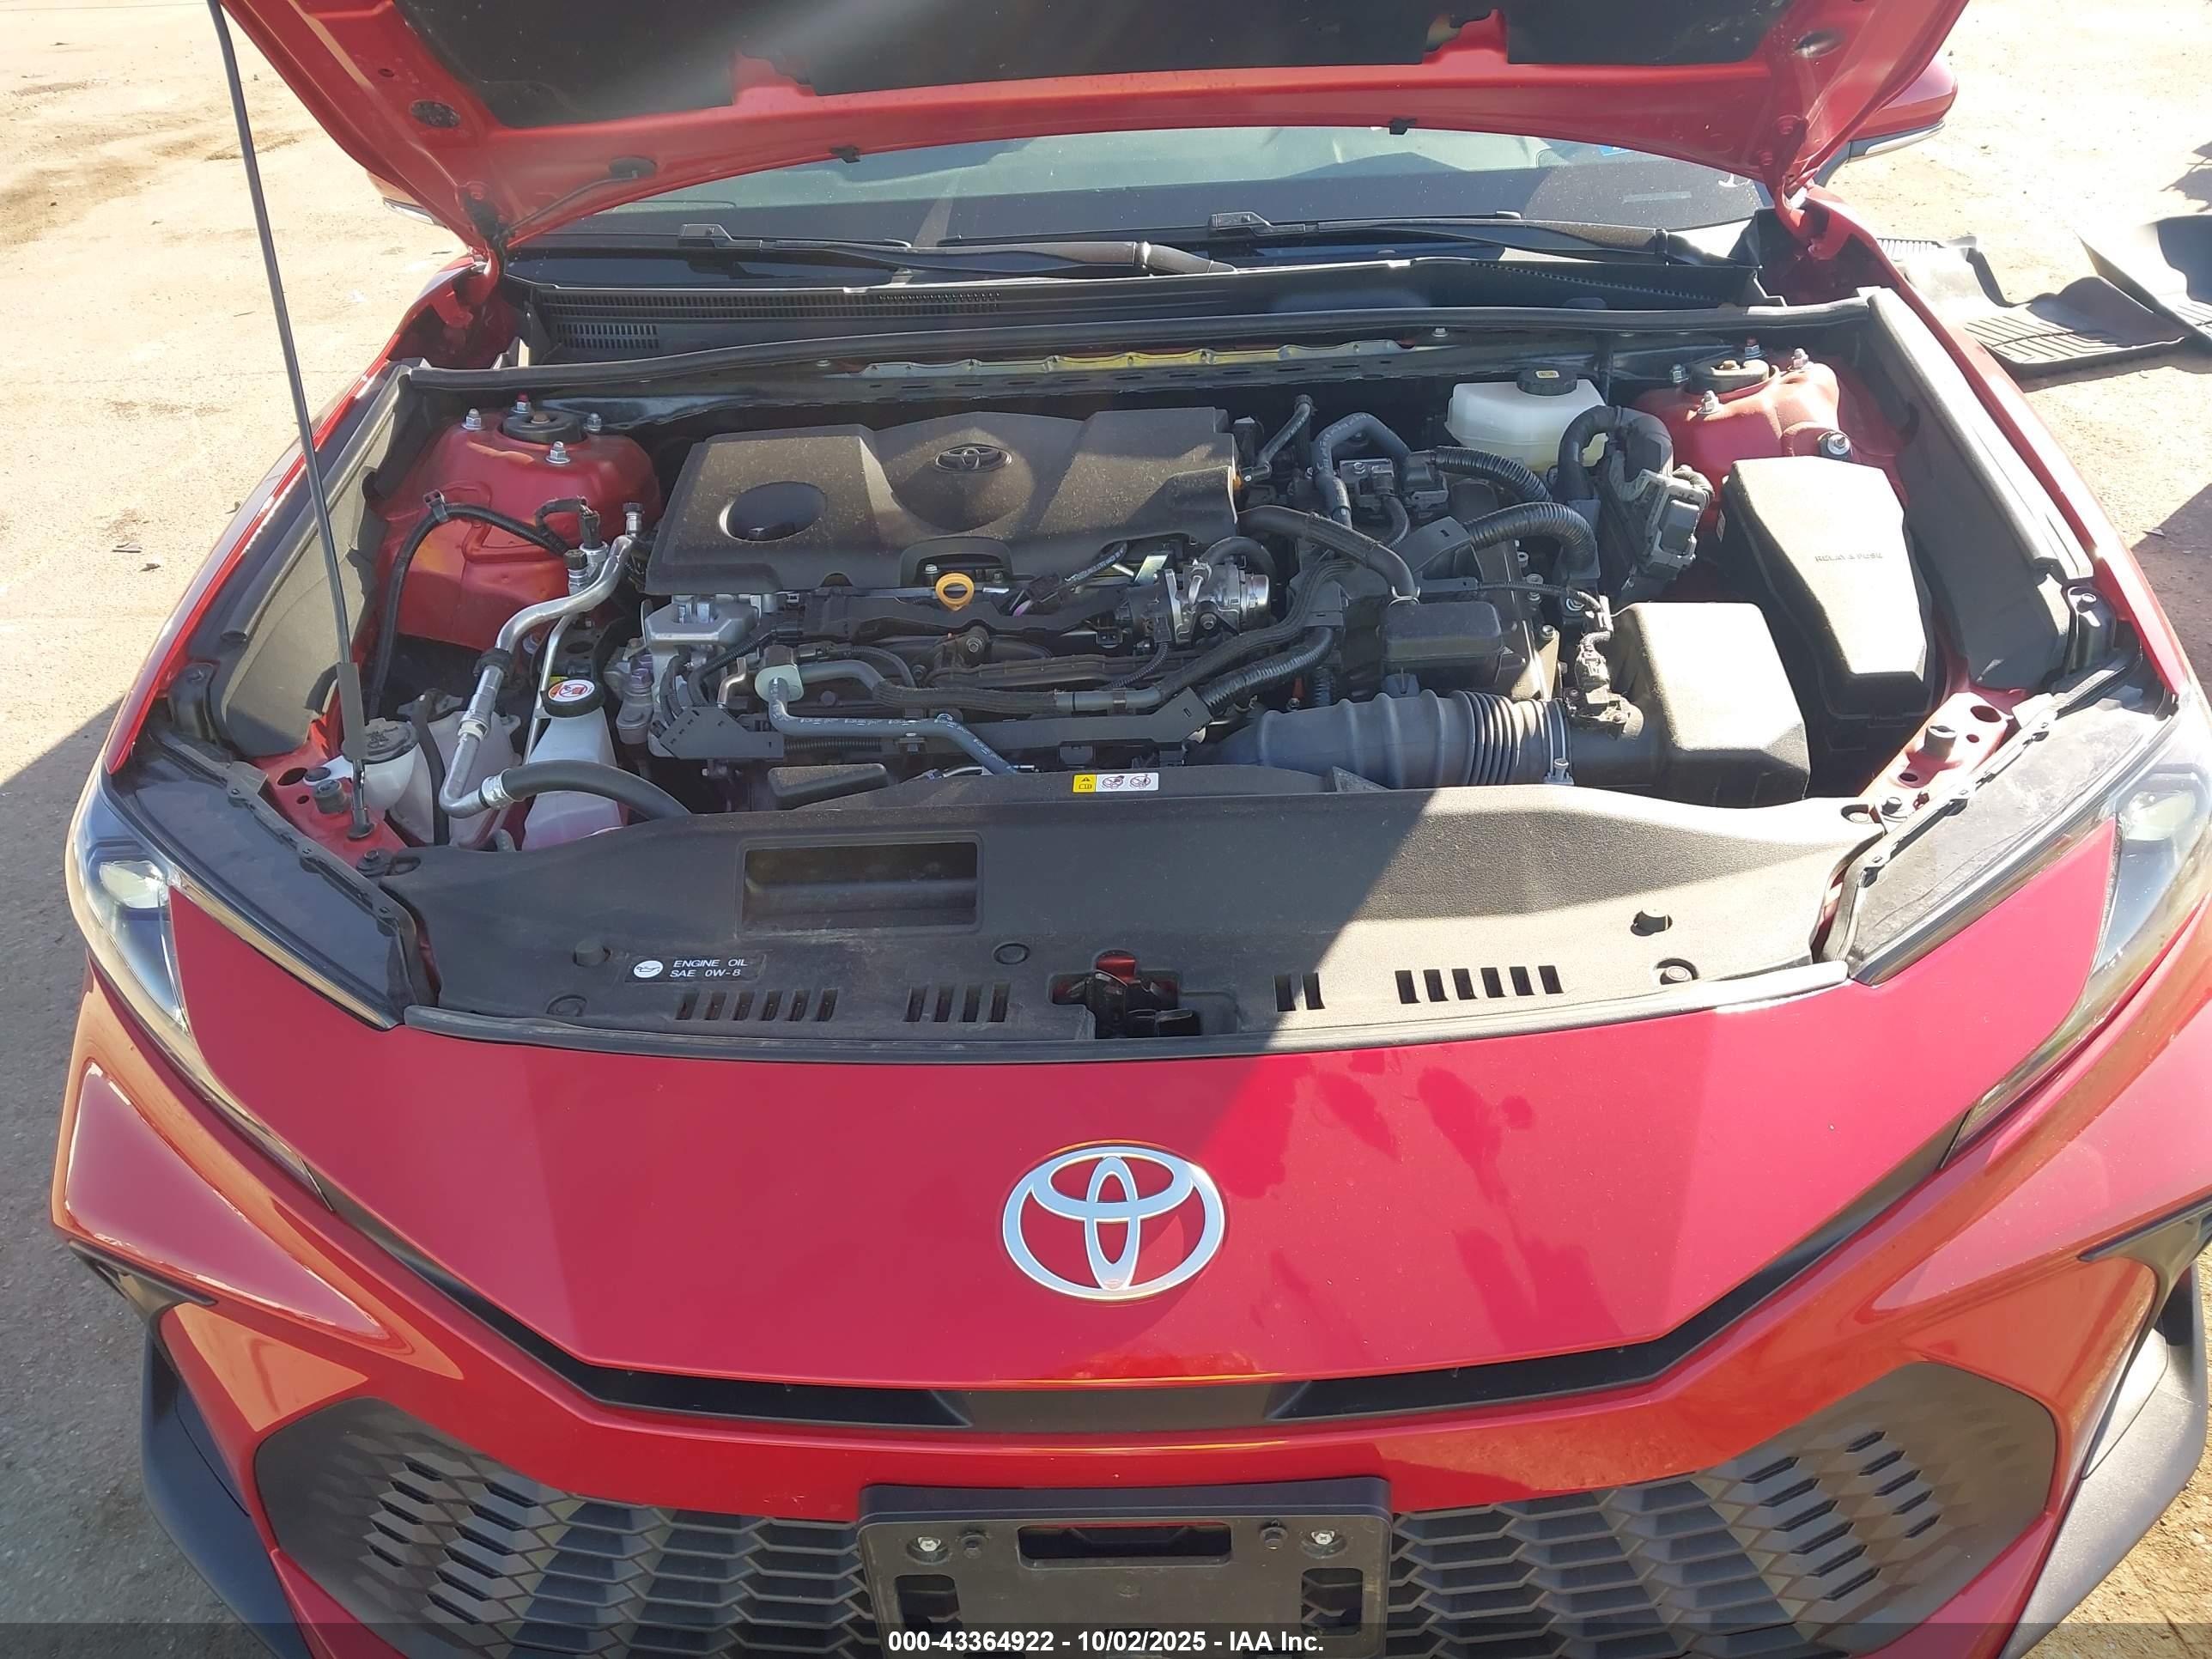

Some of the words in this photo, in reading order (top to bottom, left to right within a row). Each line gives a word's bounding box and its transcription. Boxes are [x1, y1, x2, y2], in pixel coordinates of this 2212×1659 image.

[672, 959, 720, 968] ENGINE
[728, 958, 749, 967] OIL
[670, 969, 696, 978] SAE
[705, 968, 742, 977] 0W-8
